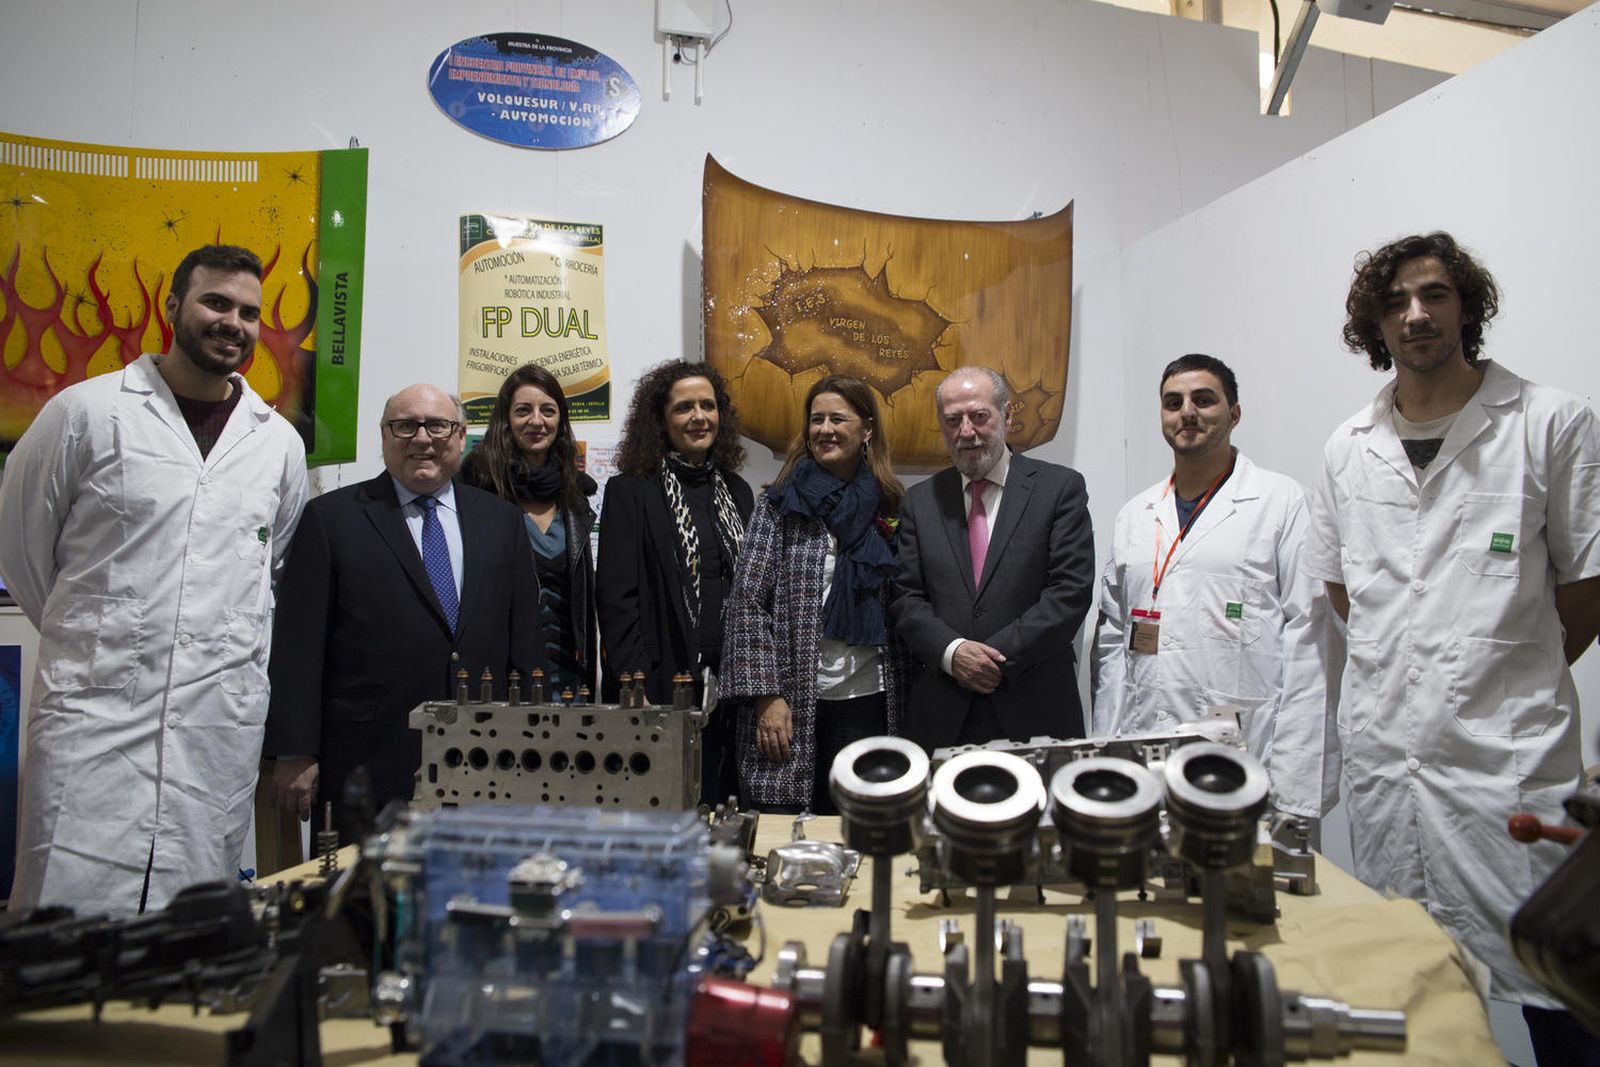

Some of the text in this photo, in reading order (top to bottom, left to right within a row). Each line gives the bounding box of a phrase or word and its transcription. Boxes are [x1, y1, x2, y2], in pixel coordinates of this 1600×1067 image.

[506, 61, 552, 76] PROVINCIAL
[477, 92, 558, 110] VOLQUESUR
[474, 251, 525, 273] AUTOMOCIÓN
[509, 275, 562, 286] AUTOMATIZACIÓN
[332, 272, 348, 366] BELLAVISTA
[482, 306, 598, 340] FP DUAL
[829, 317, 866, 330] VIRGEN
[853, 332, 890, 345] DE LOS
[469, 347, 518, 366] INSTALACIONES
[559, 346, 592, 362] ENERGÉTICA
[879, 348, 910, 359] REYES
[466, 360, 510, 377] FRIGORÍFICAS
[562, 363, 580, 377] SOLAR
